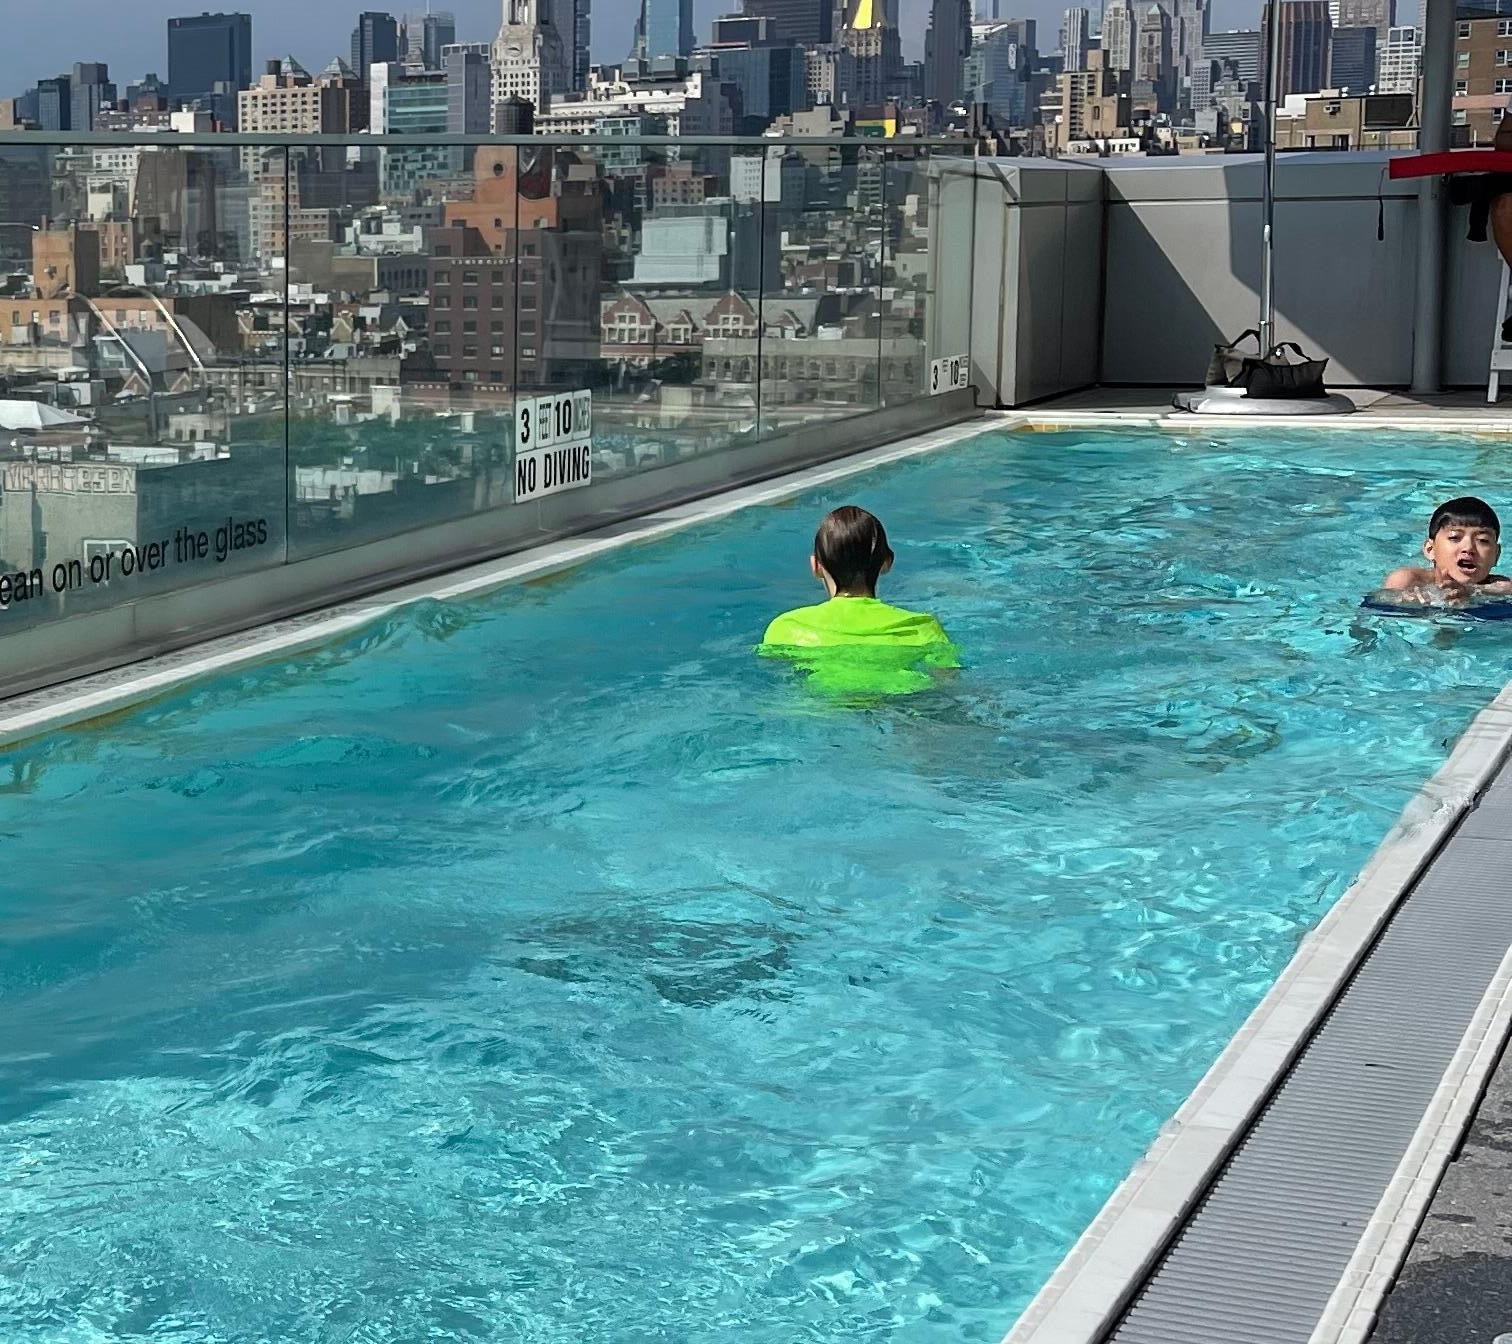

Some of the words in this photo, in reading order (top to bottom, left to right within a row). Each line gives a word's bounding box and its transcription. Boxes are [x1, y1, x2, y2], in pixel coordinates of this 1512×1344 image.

[933, 365, 938, 390] 3
[521, 408, 530, 443] 3
[555, 399, 571, 436] 10
[518, 457, 536, 496] NO
[544, 446, 589, 488] DIVING
[52, 559, 82, 593] on
[91, 550, 114, 583] or
[121, 537, 170, 576] over
[176, 526, 209, 563] the
[216, 517, 267, 562] glass
